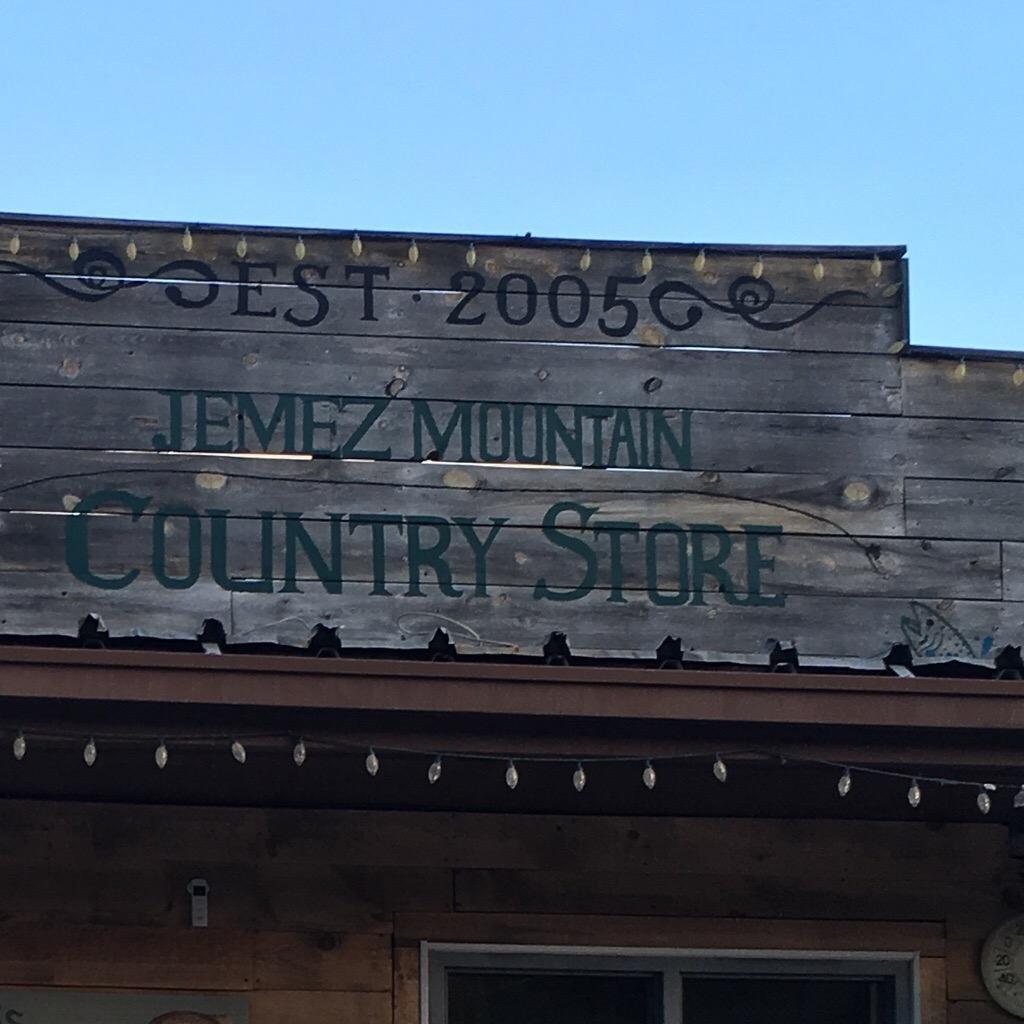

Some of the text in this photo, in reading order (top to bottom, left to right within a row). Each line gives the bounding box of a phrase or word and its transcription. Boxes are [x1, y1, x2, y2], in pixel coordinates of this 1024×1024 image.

[446, 270, 647, 337] 2005
[152, 390, 694, 470] JEMEZ MOUNTAIN
[64, 490, 786, 608] COUNTRY STORE
